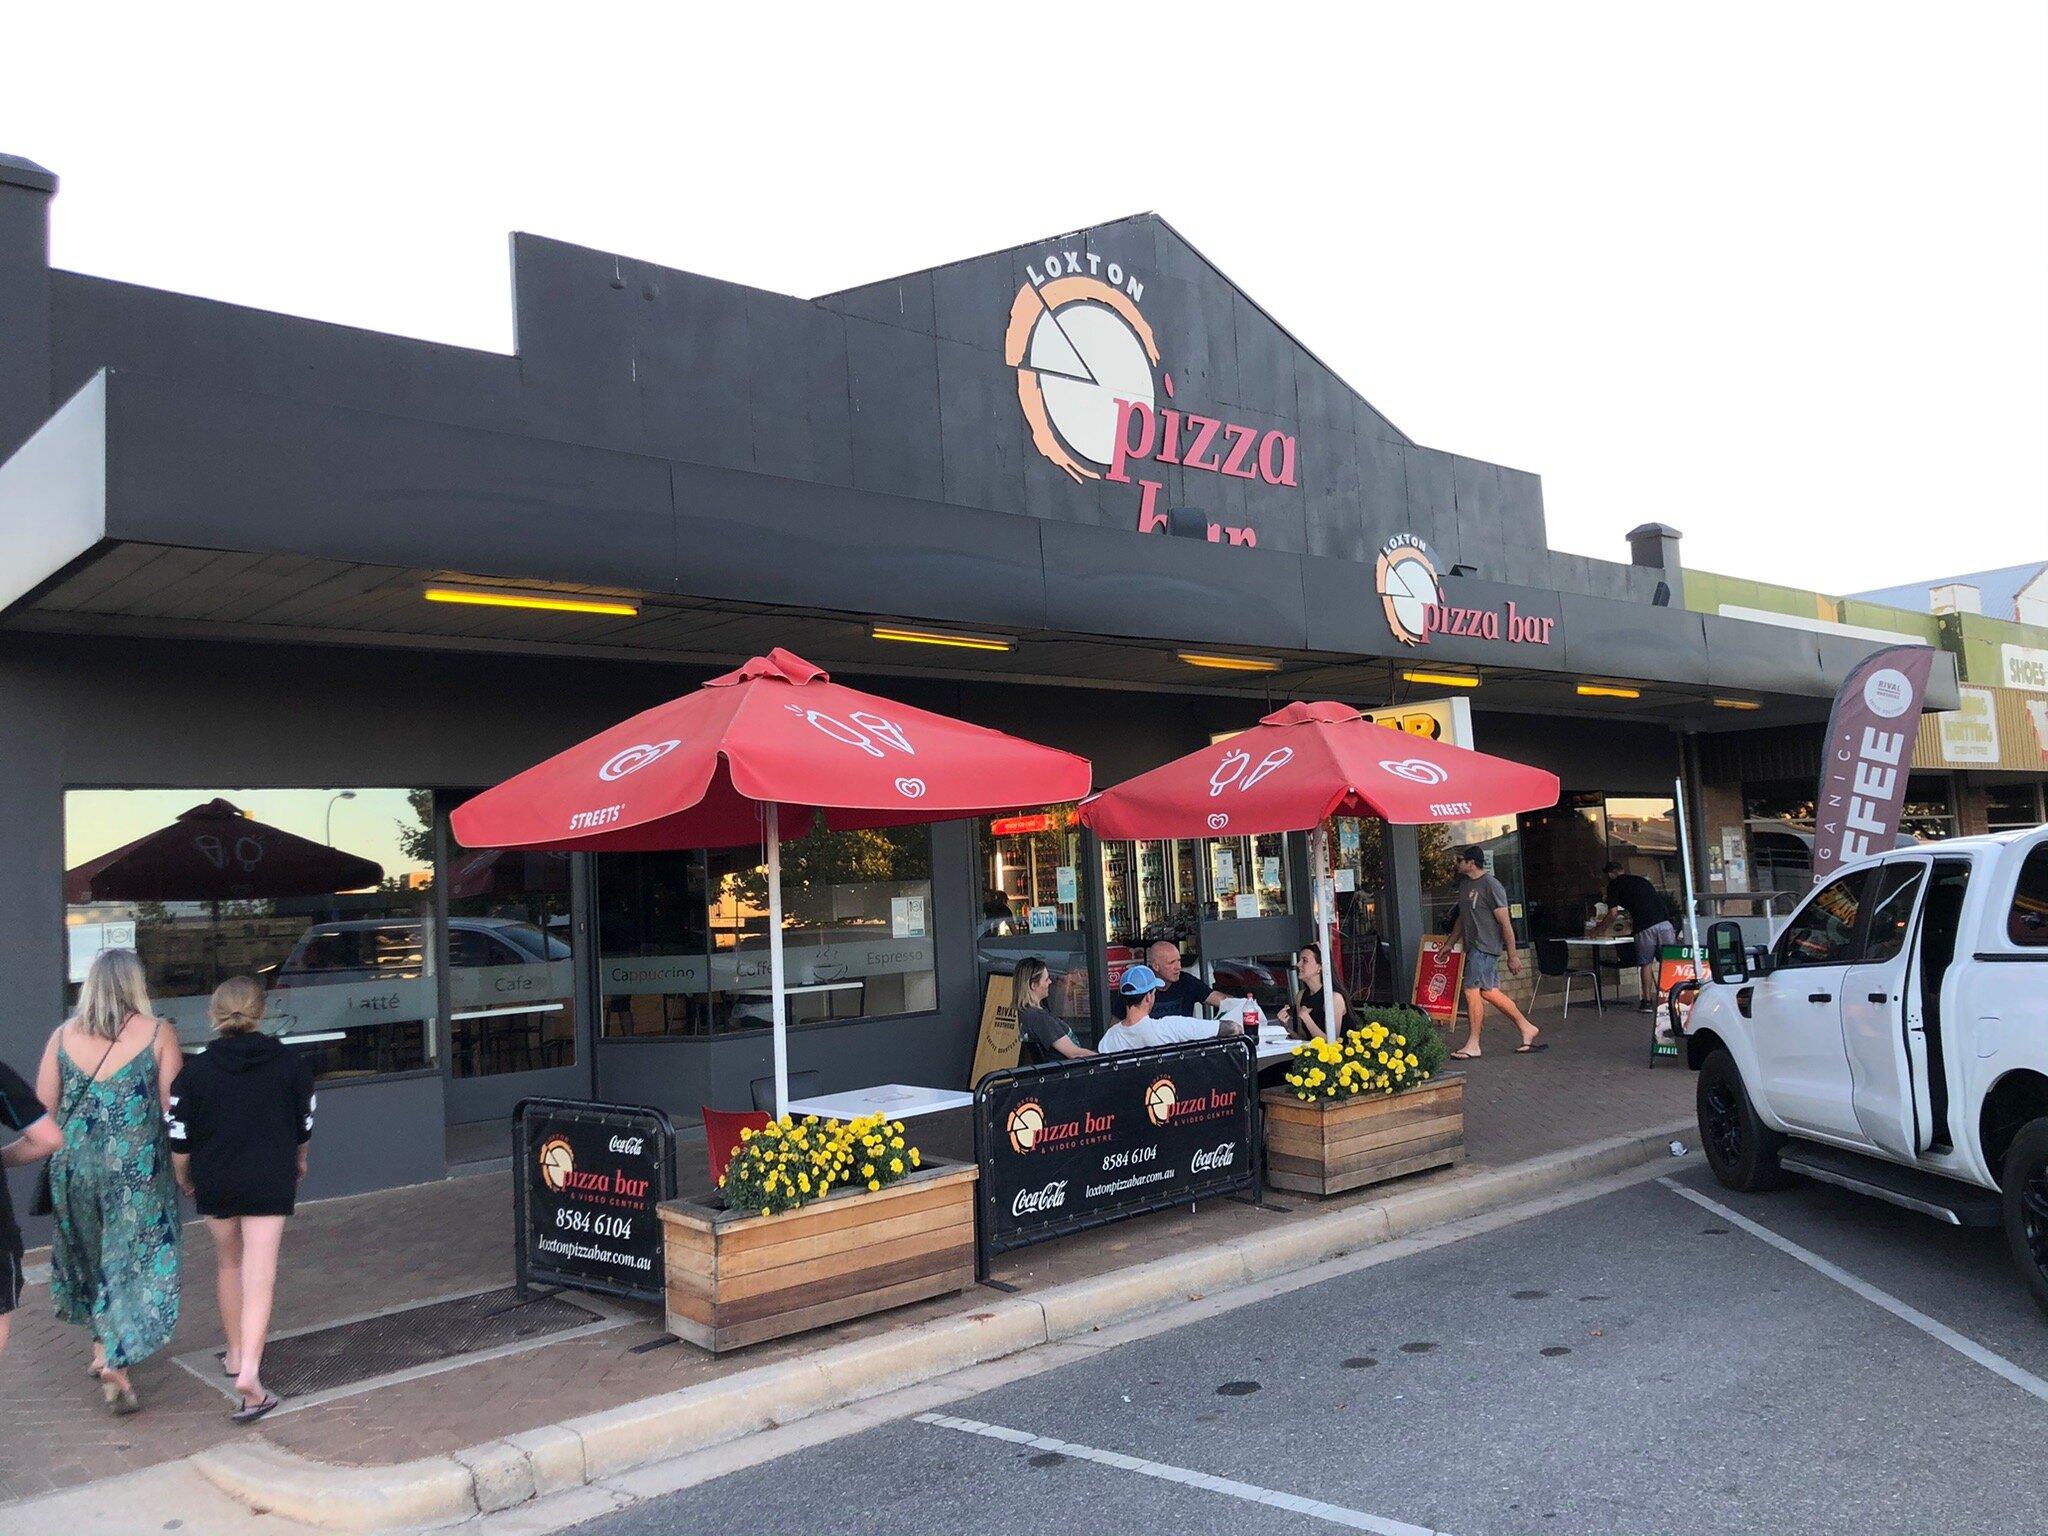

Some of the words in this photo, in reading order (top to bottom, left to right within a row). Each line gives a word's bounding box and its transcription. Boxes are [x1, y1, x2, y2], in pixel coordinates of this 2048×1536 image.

[1026, 251, 1144, 303] LOXTON
[1105, 373, 1297, 487] pizza
[1382, 533, 1427, 556] LOXTON
[1419, 586, 1500, 645] pizza
[1507, 601, 1556, 645] bar
[2008, 657, 2047, 687] SHOES
[1877, 680, 1902, 692] RIVAL
[569, 806, 621, 831] STREETS
[1430, 802, 1471, 817] STREETS
[1032, 910, 1055, 929] ENTER
[866, 949, 923, 966] Espresso
[996, 1005, 1018, 1018] RIVAL
[1166, 1094, 1207, 1124] pizza
[1210, 1087, 1237, 1109] bar
[1181, 1114, 1205, 1125] VIDEO
[1207, 1109, 1235, 1121] CENTRE
[1030, 1119, 1080, 1152] pizza
[1084, 1111, 1116, 1135] bar
[1049, 1141, 1077, 1153] VIDEO
[1080, 1133, 1114, 1147] CENTRE
[1102, 1150, 1130, 1171] 8584
[1131, 1144, 1158, 1165] 6104
[561, 1164, 610, 1193] pizza
[614, 1167, 649, 1198] bar
[1085, 1167, 1176, 1199] loxtonpizzabar.com.au
[579, 1193, 607, 1206] VIDEO
[609, 1198, 646, 1211] CENTRE
[555, 1207, 592, 1233] 8584
[594, 1213, 633, 1240] 6104
[538, 1233, 652, 1271] loxtonpizzabar.com.au
